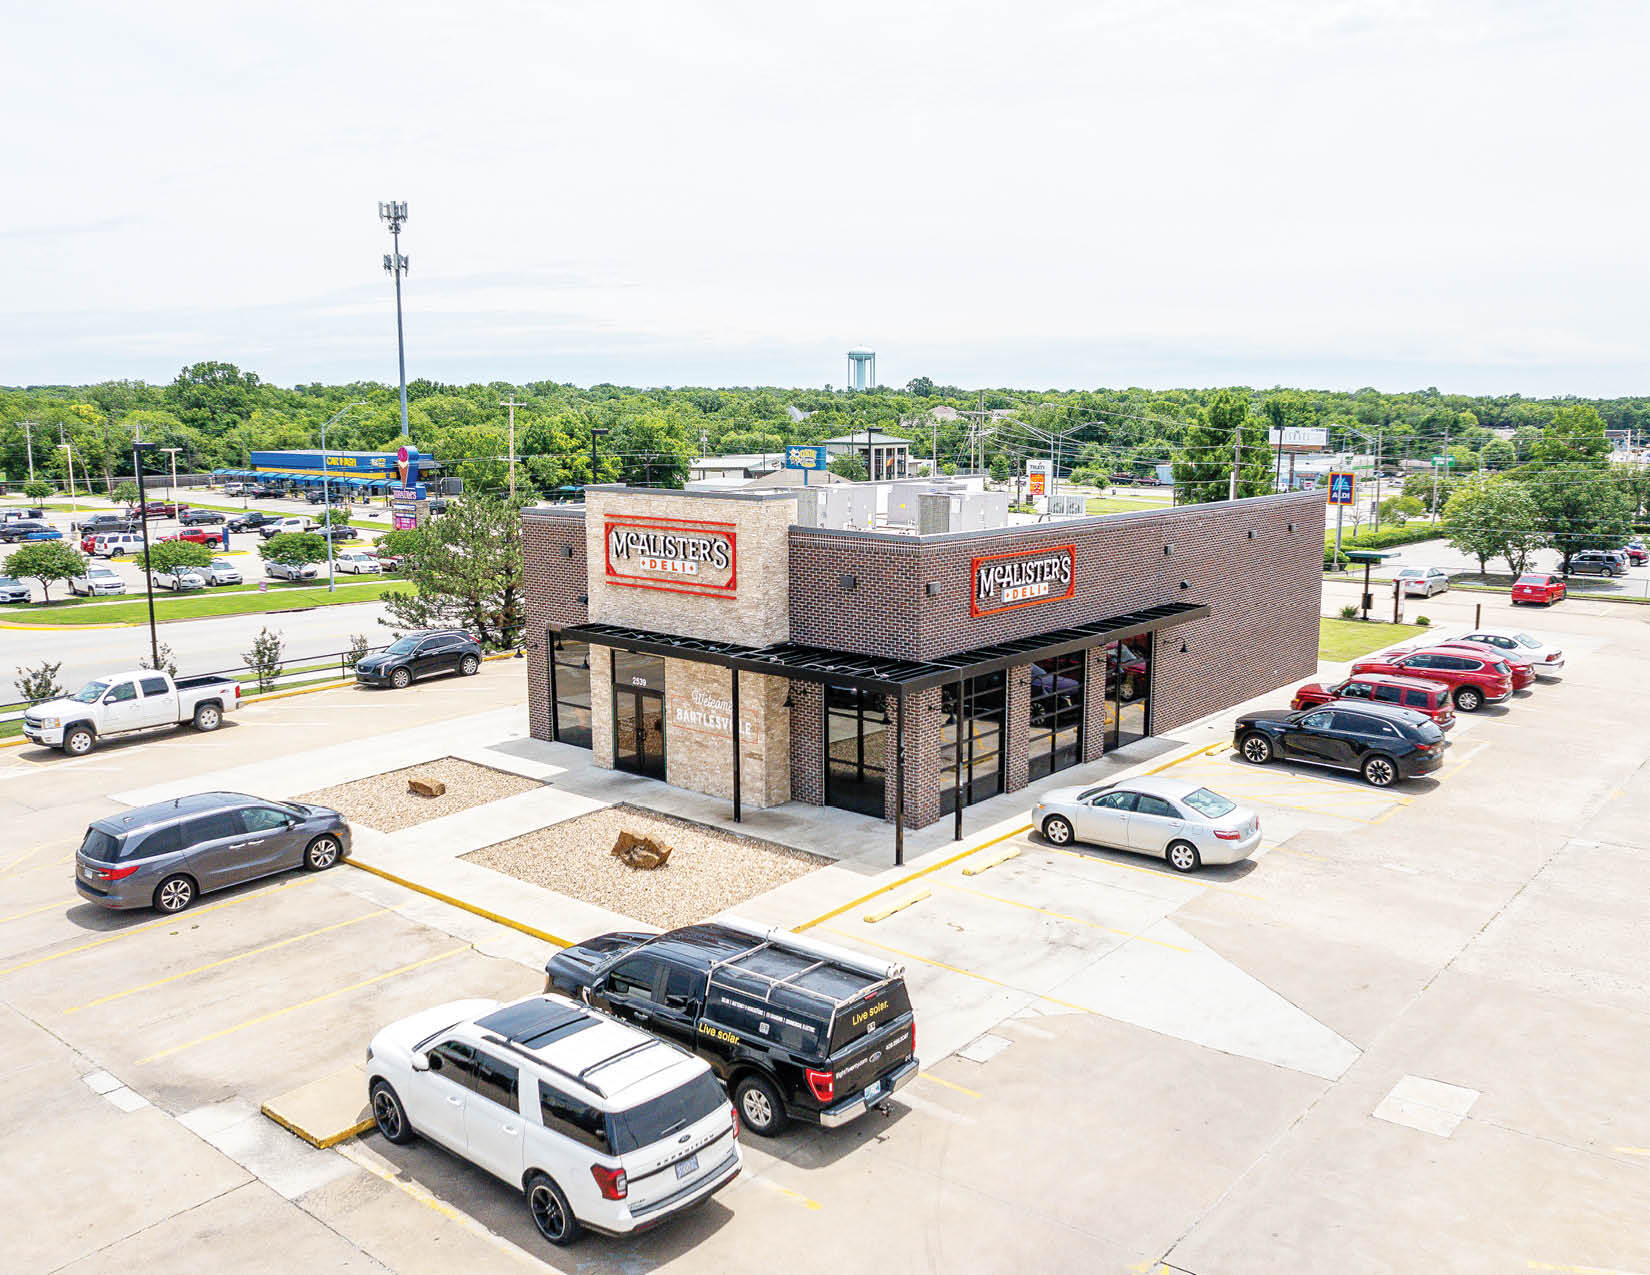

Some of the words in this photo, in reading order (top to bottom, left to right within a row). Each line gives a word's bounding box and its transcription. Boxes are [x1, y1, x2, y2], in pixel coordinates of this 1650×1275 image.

[649, 559, 687, 573] DELI
[1012, 584, 1041, 600] DELI
[632, 676, 647, 687] 2539
[676, 708, 751, 737] BARTLESVILE
[852, 1011, 868, 1027] Live
[869, 1000, 889, 1017] solar.
[698, 1021, 717, 1037] Live
[717, 1030, 741, 1046] solar.
